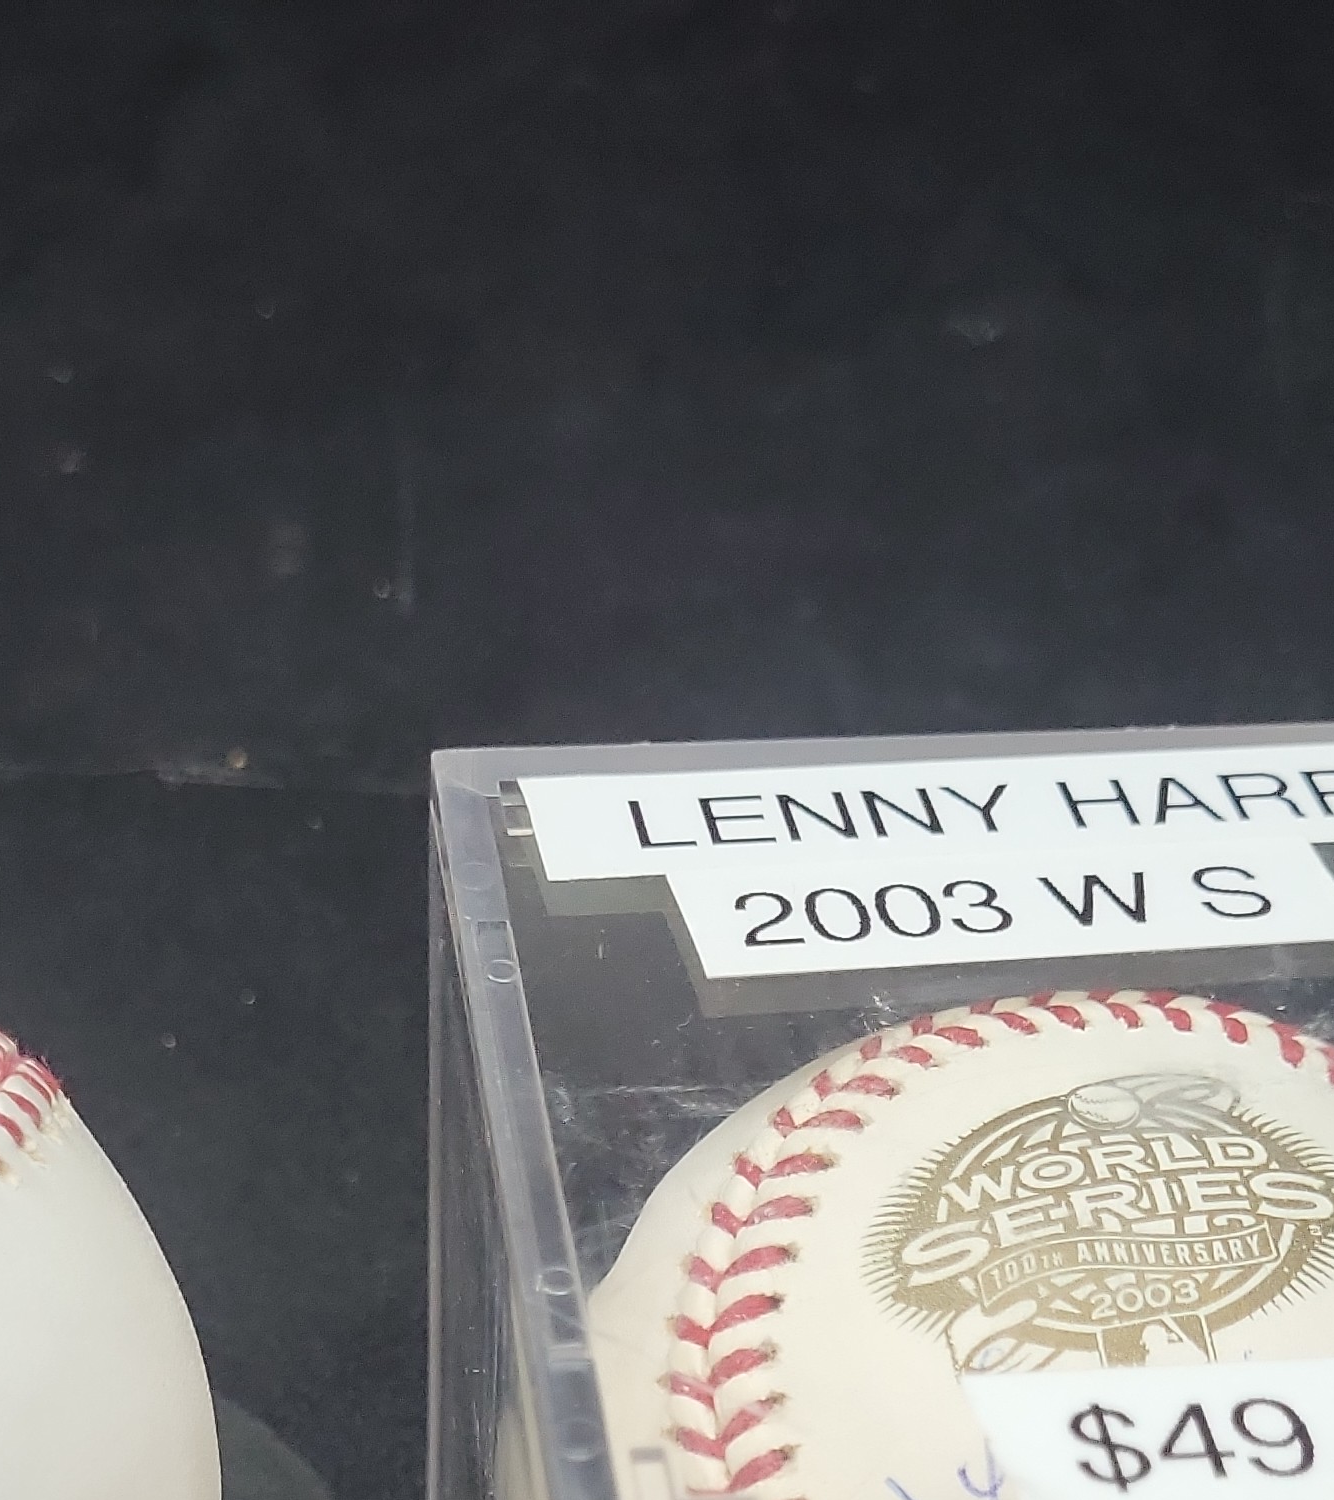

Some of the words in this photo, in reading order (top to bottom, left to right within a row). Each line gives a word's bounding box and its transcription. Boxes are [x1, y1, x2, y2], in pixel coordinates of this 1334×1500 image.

[628, 782, 1011, 850] LENNY
[733, 877, 1014, 946] 2003
[1038, 868, 1148, 926] W
[1200, 864, 1274, 920] S
[942, 1134, 1269, 1213] WORLD
[1076, 1232, 1261, 1267] ANNIVERSARY
[1091, 1277, 1200, 1320] 2003
